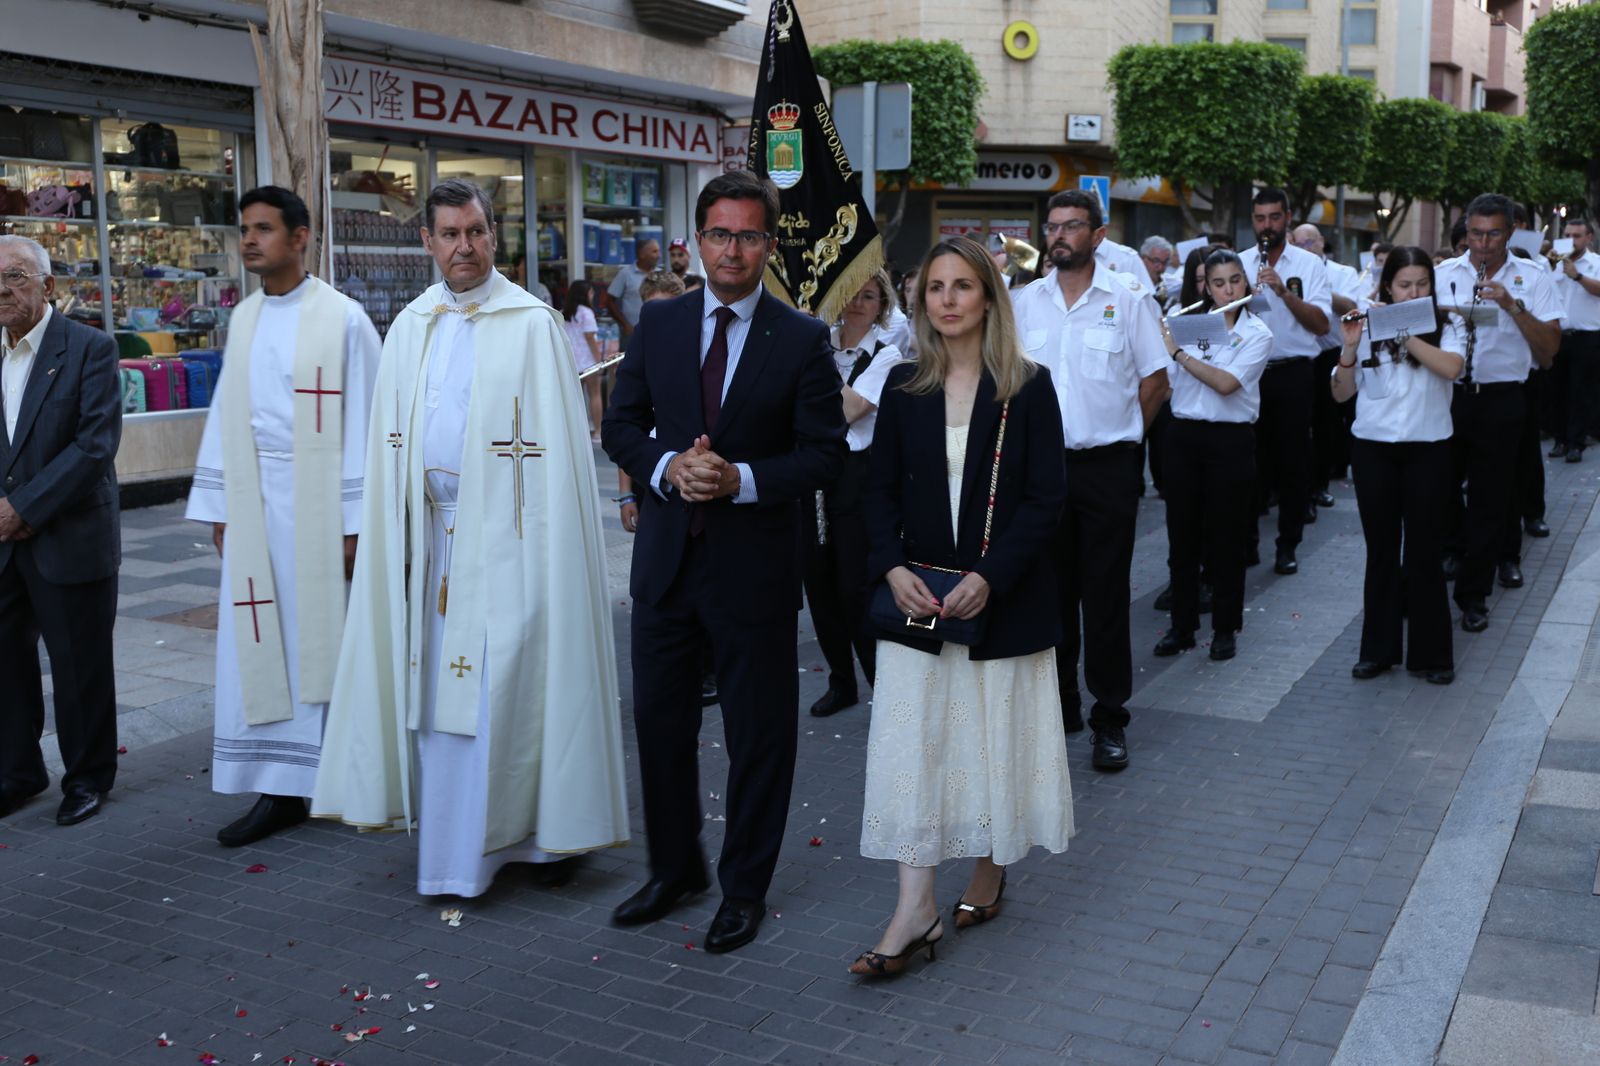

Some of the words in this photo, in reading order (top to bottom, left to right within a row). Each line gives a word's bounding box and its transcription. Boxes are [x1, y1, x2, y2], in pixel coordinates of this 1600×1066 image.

[326, 65, 404, 121] 兴隆
[412, 81, 579, 138] BAZAR
[592, 109, 713, 154] CHINA
[724, 146, 746, 157] BA
[814, 102, 853, 183] SINFONICA
[726, 160, 747, 171] CH
[978, 162, 1035, 179] mero
